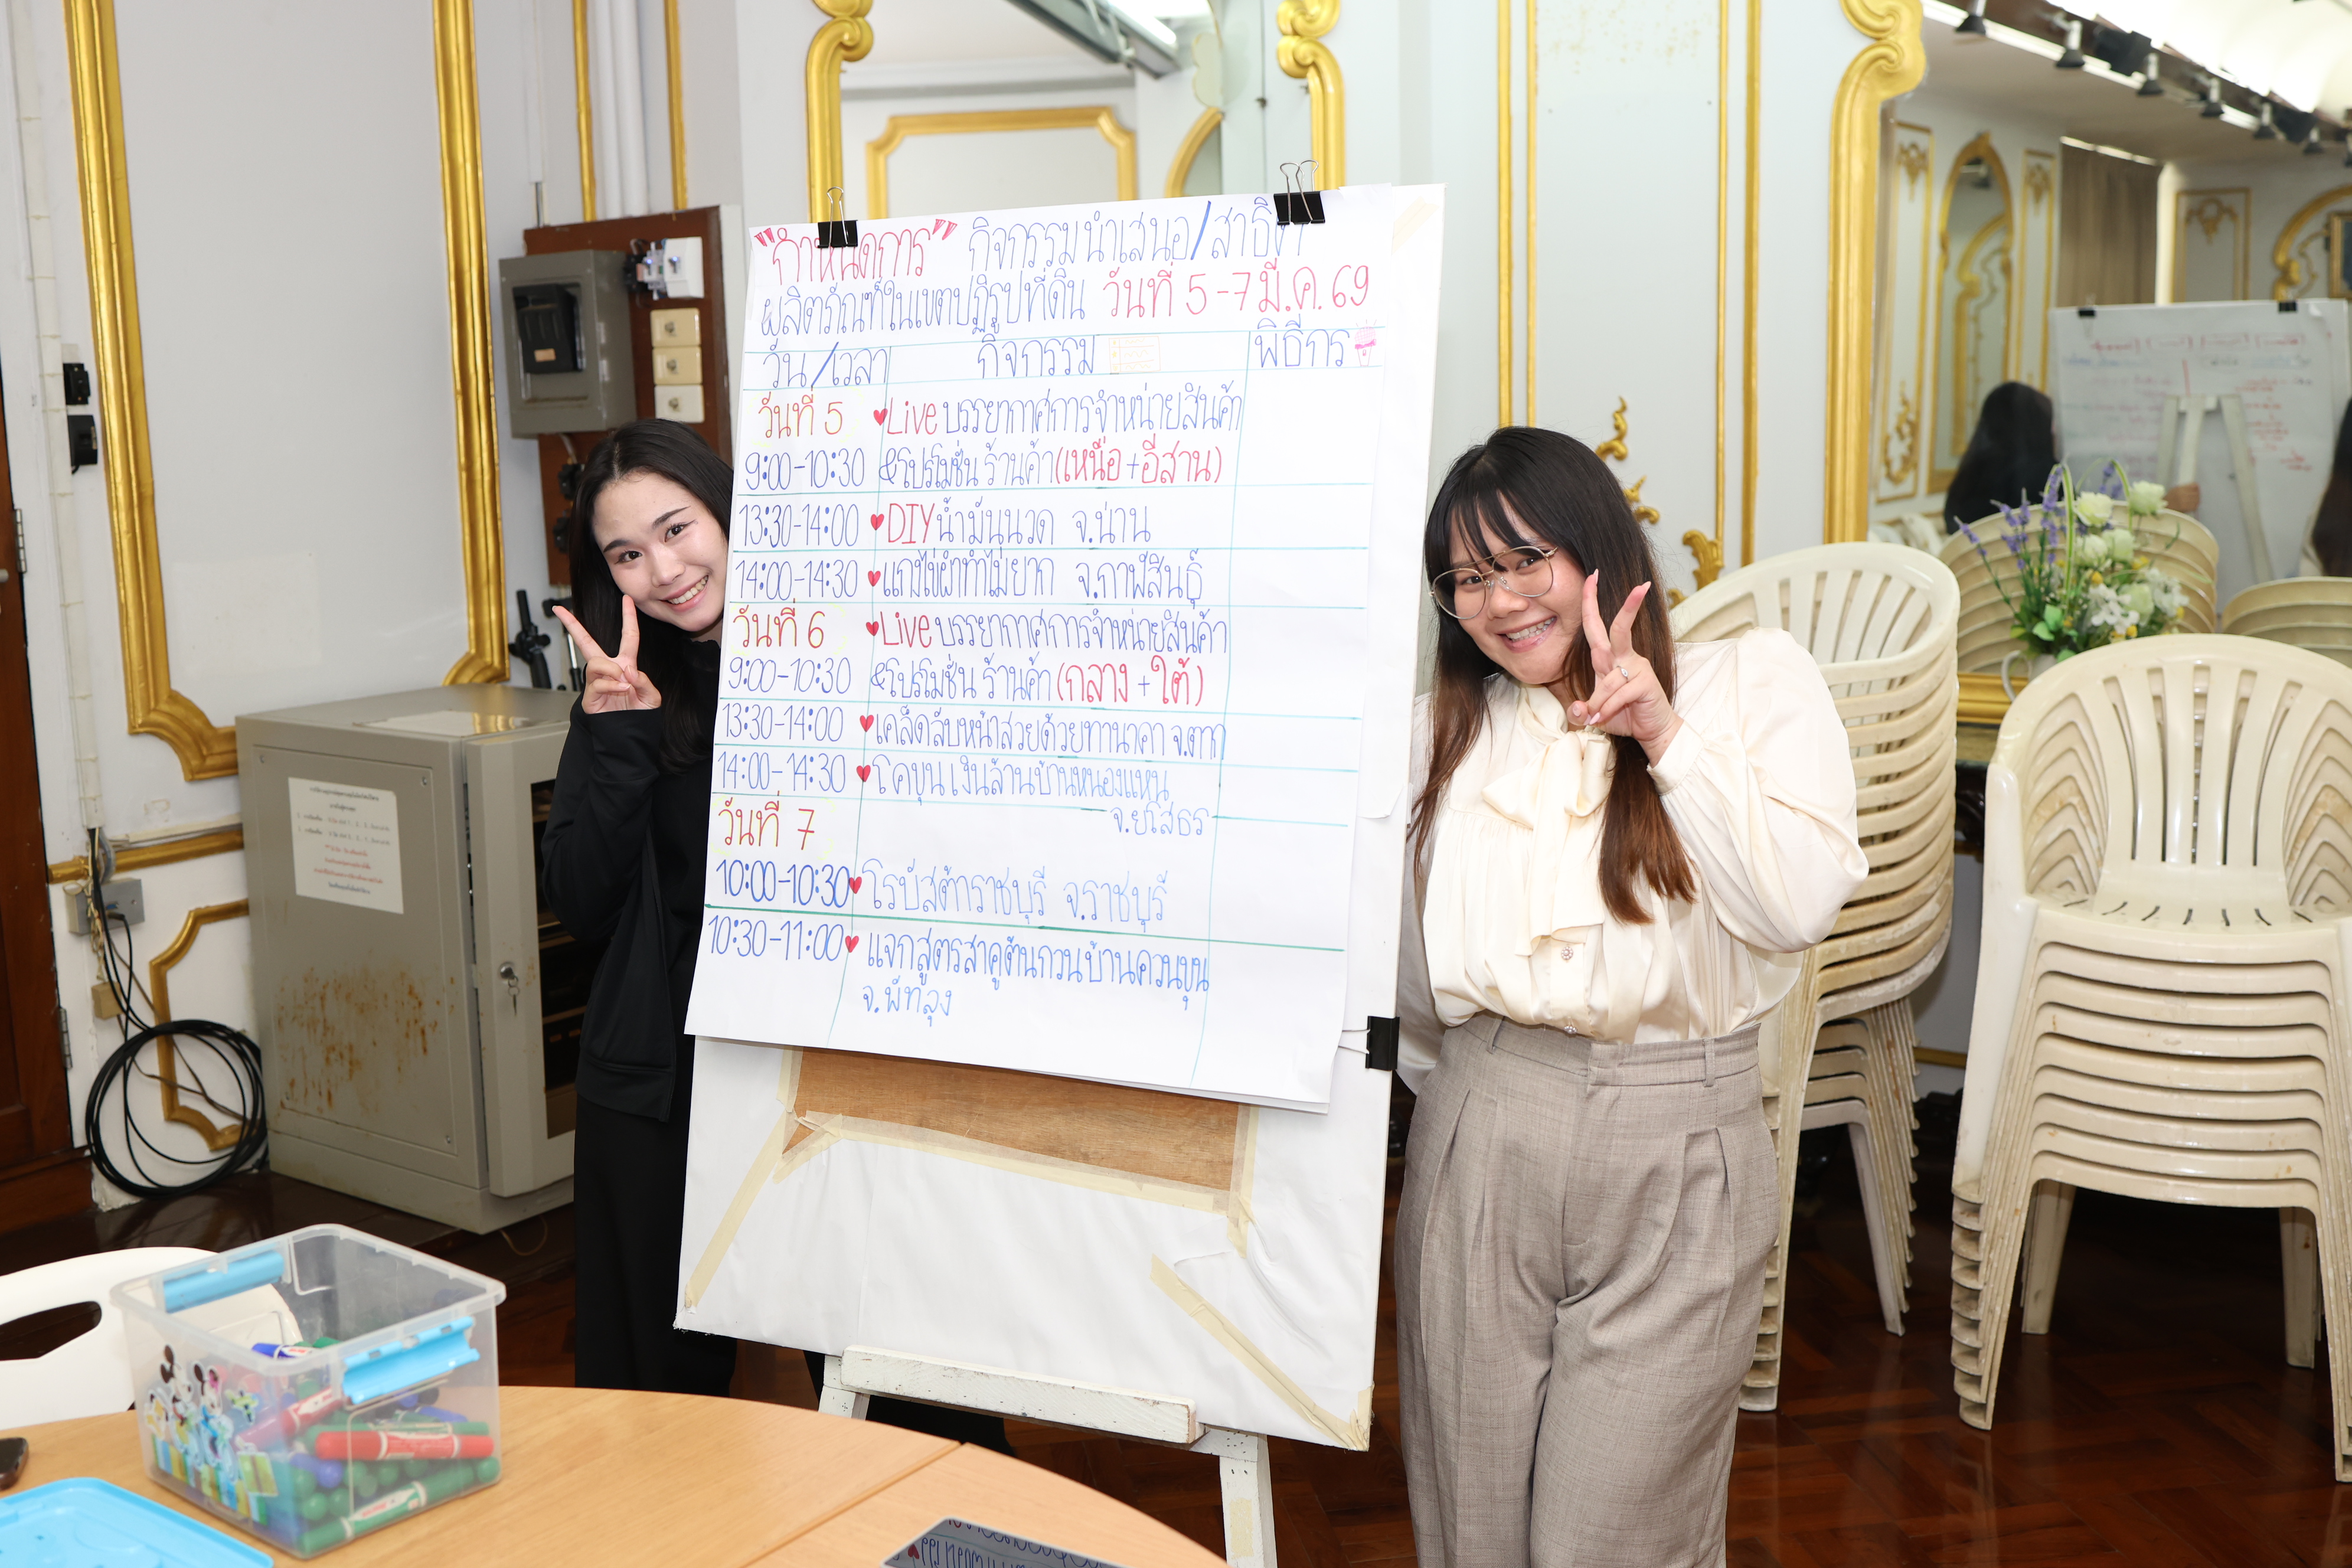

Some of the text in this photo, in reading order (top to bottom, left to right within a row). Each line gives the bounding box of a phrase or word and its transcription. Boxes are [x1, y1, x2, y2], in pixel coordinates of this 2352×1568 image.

[1103, 262, 1174, 318] วันที่
[1332, 264, 1370, 308] 69
[978, 333, 1095, 379] กิจกรรม
[1255, 313, 1350, 368] พิธีกร
[759, 386, 843, 439] วันที่ 5
[887, 397, 937, 435] Live
[745, 447, 864, 491] 9:00-10:30
[739, 504, 859, 547] 13:30-14:00
[887, 495, 1151, 545] DIY น้ำมันนวด จ.น่าน
[735, 559, 858, 600] 14:00-14:30
[733, 597, 825, 649] วันที่ 6
[880, 611, 932, 648] Live
[728, 656, 851, 694] 9:00-10:30
[722, 703, 844, 742] 13:30-14:00
[717, 752, 845, 793] 14:00-14:30
[718, 790, 815, 851] วันที่ 7
[1110, 801, 1209, 837] จ.ยโสธร
[716, 859, 851, 908] 10:00-10:30
[708, 914, 844, 961] 10:30-11:00
